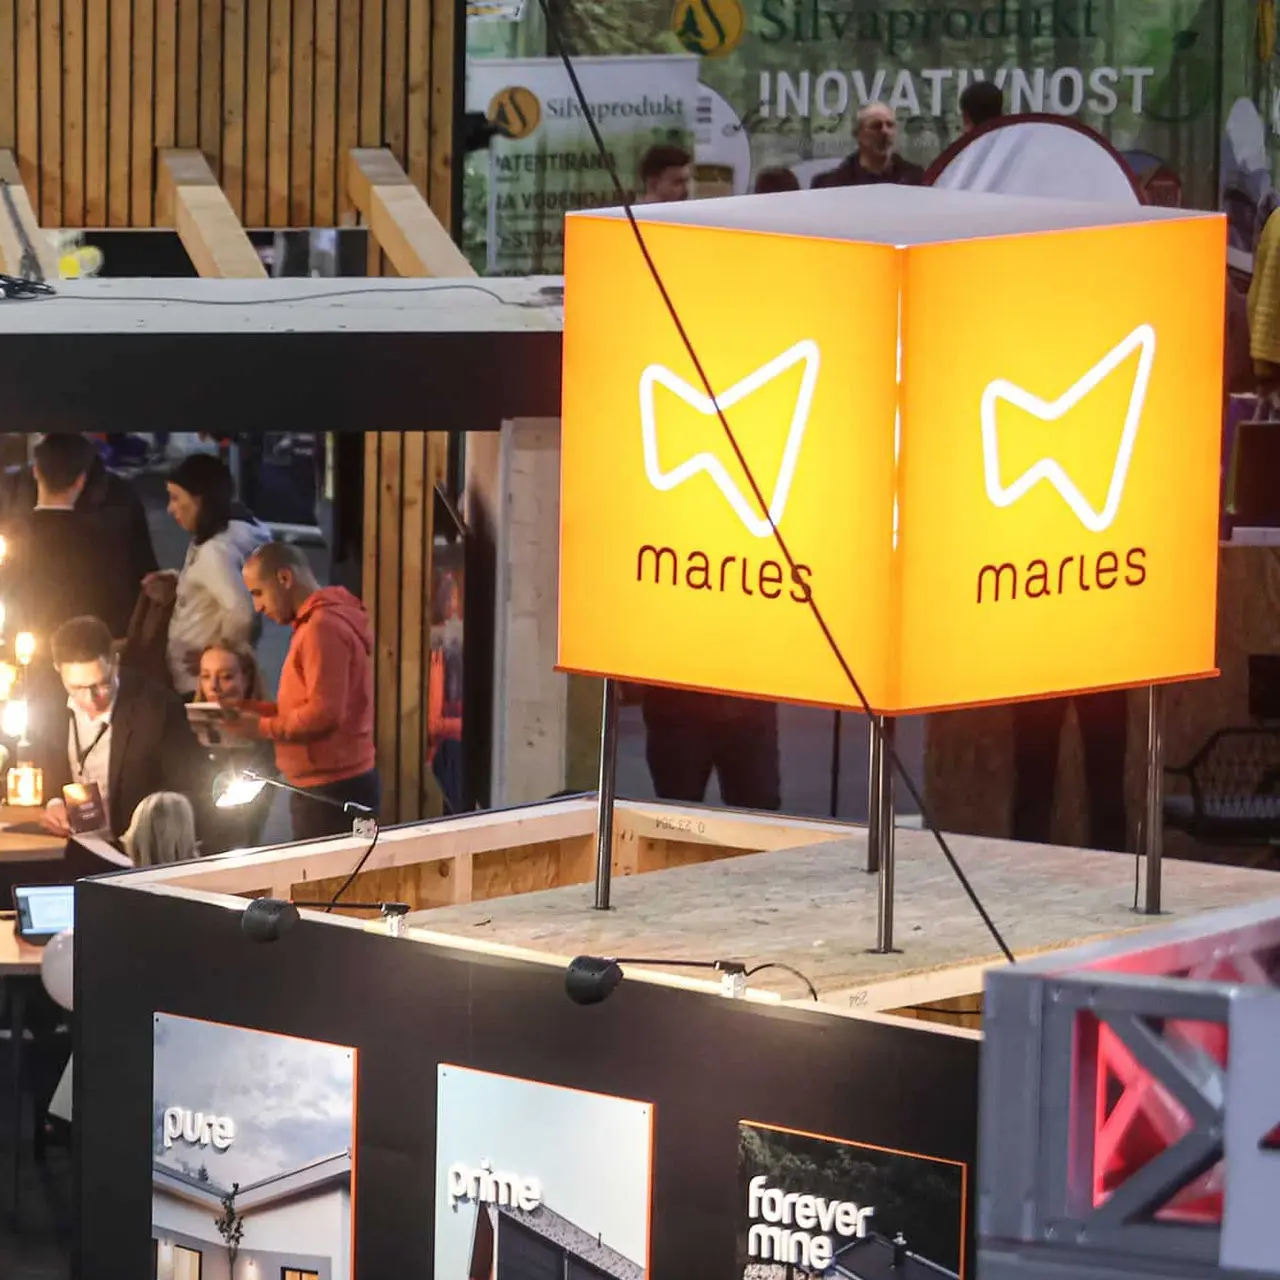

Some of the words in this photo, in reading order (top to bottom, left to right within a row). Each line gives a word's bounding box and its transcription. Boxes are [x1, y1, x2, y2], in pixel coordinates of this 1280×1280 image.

[546, 95, 684, 122] Silvaprodukt
[636, 543, 813, 604] marles
[975, 546, 1147, 604] marles
[162, 1105, 237, 1151] pure
[447, 1157, 543, 1212] prime
[748, 1175, 875, 1239] forever
[748, 1224, 833, 1271] mine
